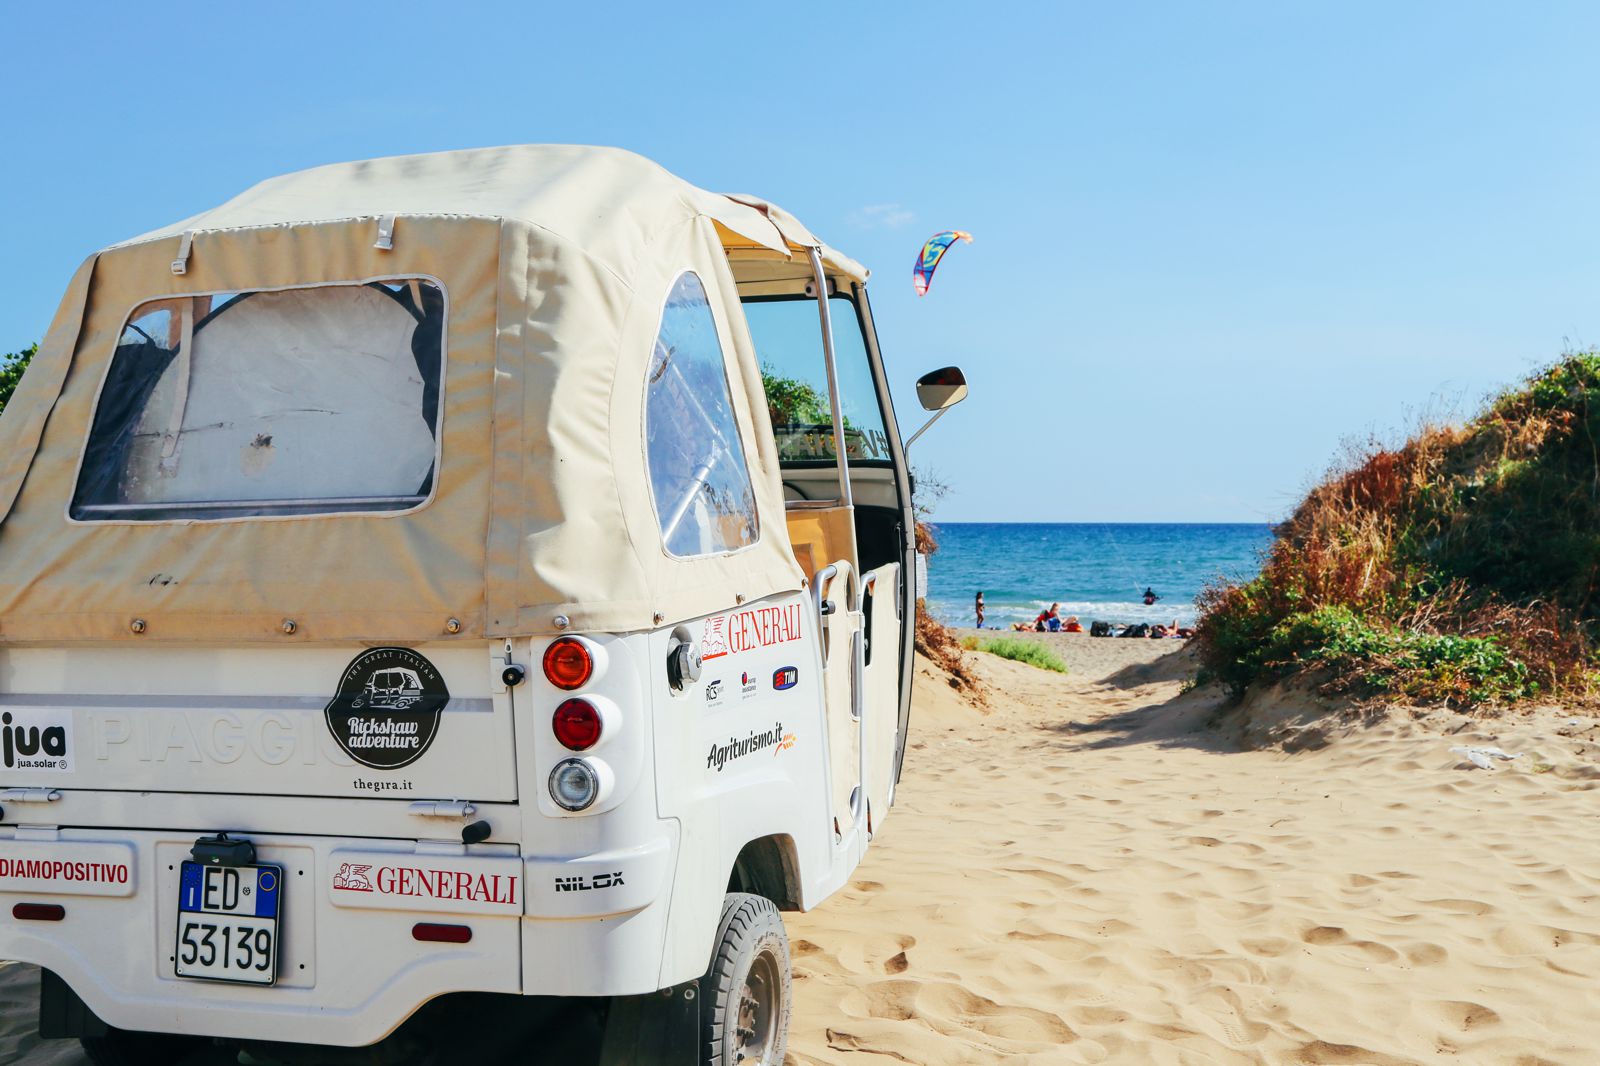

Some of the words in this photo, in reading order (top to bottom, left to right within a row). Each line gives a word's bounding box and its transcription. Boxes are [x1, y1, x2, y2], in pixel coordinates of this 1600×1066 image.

[728, 603, 802, 654] GENERALI
[347, 665, 362, 681] THE
[364, 651, 393, 664] GREAT
[399, 653, 435, 680] ITALIAN
[784, 670, 796, 685] TIM
[2, 711, 67, 768] jua
[347, 716, 418, 735] Rickshaw
[348, 733, 420, 749] adventure
[707, 721, 783, 773] Agriturismo.it
[17, 759, 57, 769] jua.solar
[0, 859, 128, 884] DIAMOPOSITIVO
[376, 866, 518, 905] GENERALI
[555, 871, 625, 893] NILOX
[203, 867, 240, 911] ED
[181, 922, 272, 972] 53139
